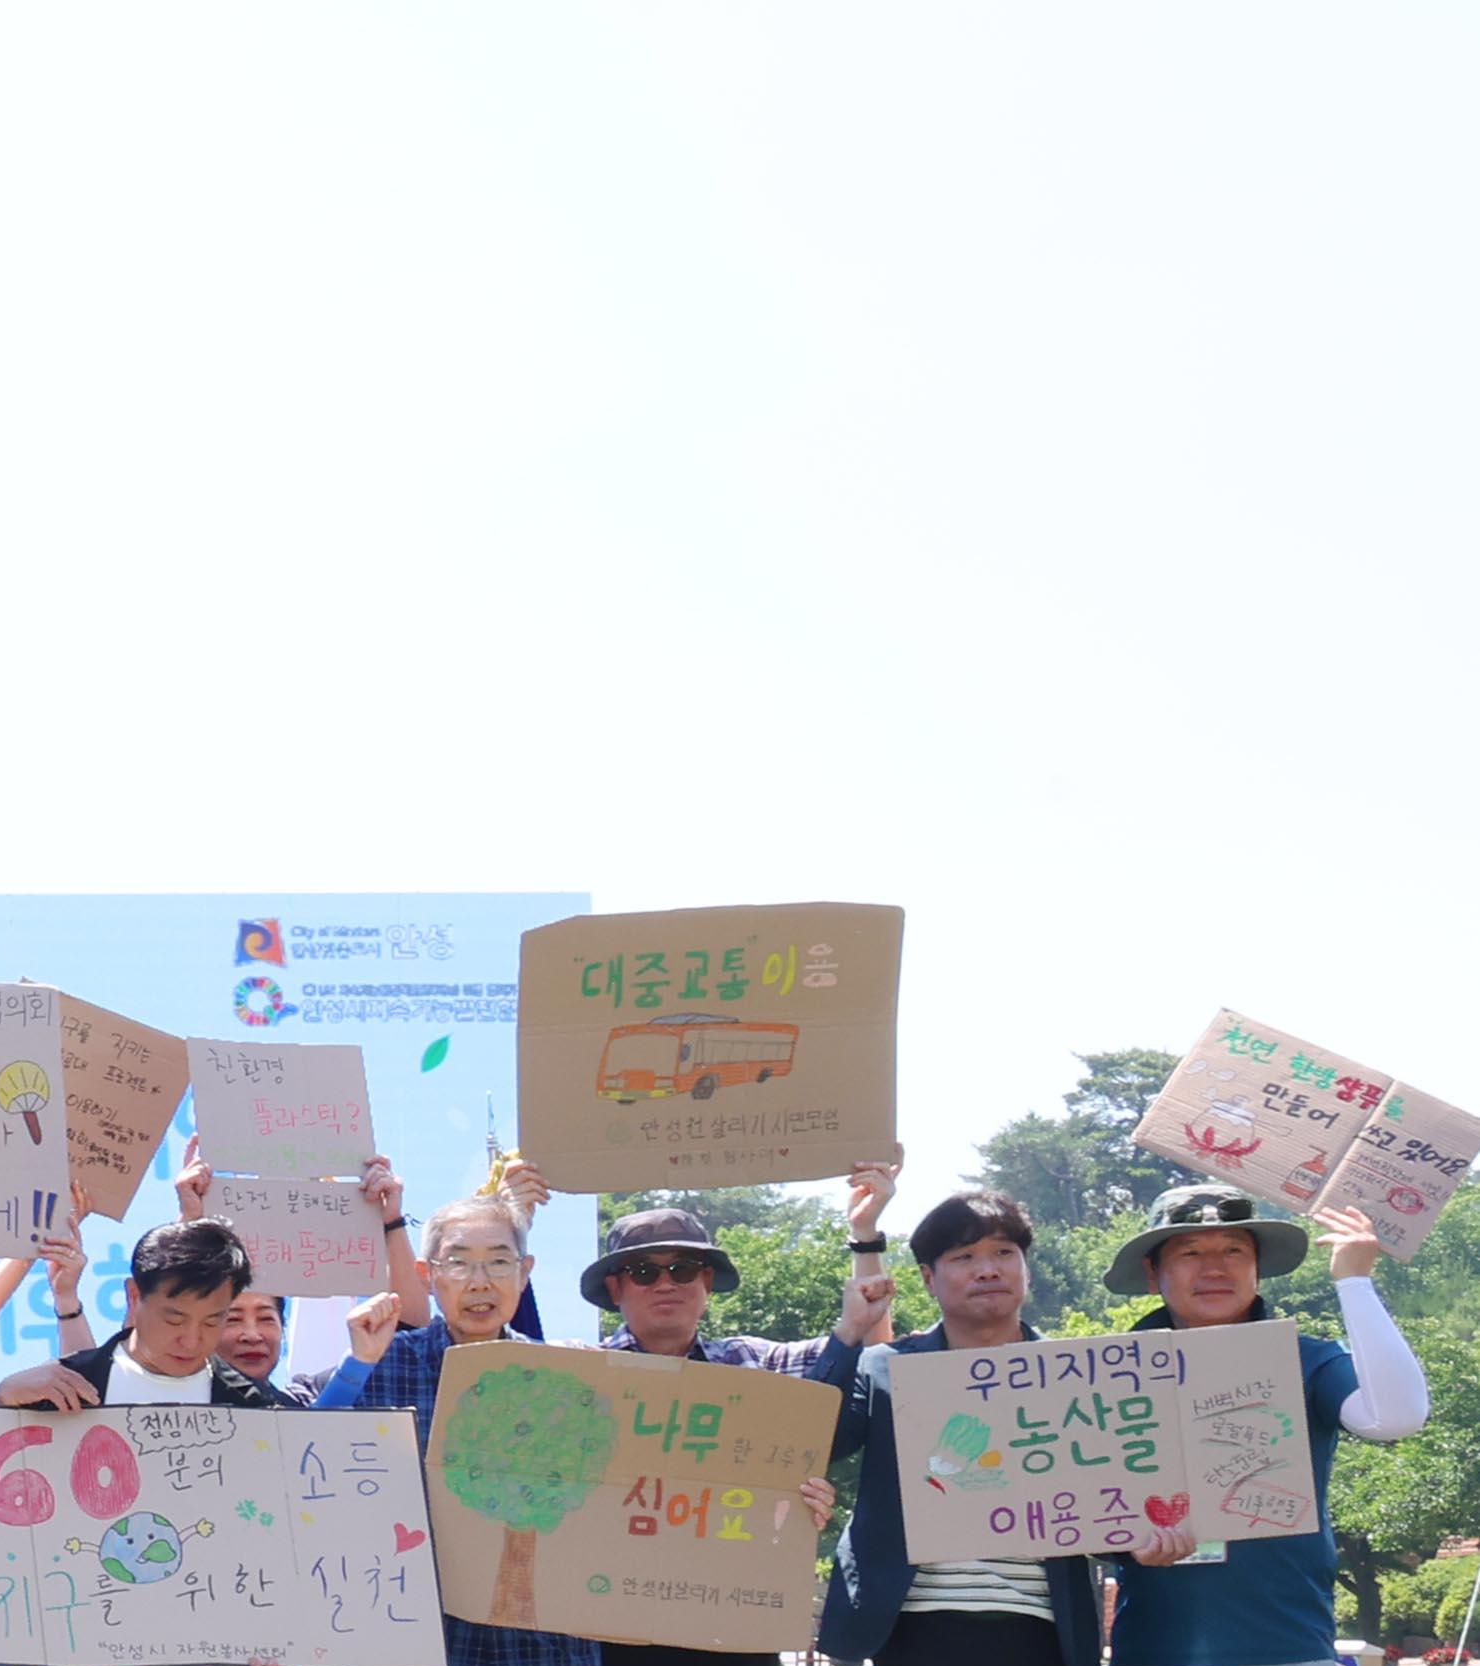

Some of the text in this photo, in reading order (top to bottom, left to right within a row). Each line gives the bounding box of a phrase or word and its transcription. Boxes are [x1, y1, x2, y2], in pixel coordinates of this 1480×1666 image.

[763, 943, 839, 997] 이용
[207, 1048, 284, 1085] 친환경
[1217, 1026, 1278, 1064] 천연
[1262, 1082, 1339, 1130] 만들어
[1397, 1138, 1470, 1178] 있어요
[141, 1413, 218, 1438] 점심시간
[1010, 1393, 1161, 1474] 농산물
[164, 1453, 223, 1490] 분의
[300, 1441, 389, 1499] 소등
[623, 1476, 790, 1544] 심어요!
[176, 1563, 274, 1610] 위한
[311, 1555, 418, 1633] 실천
